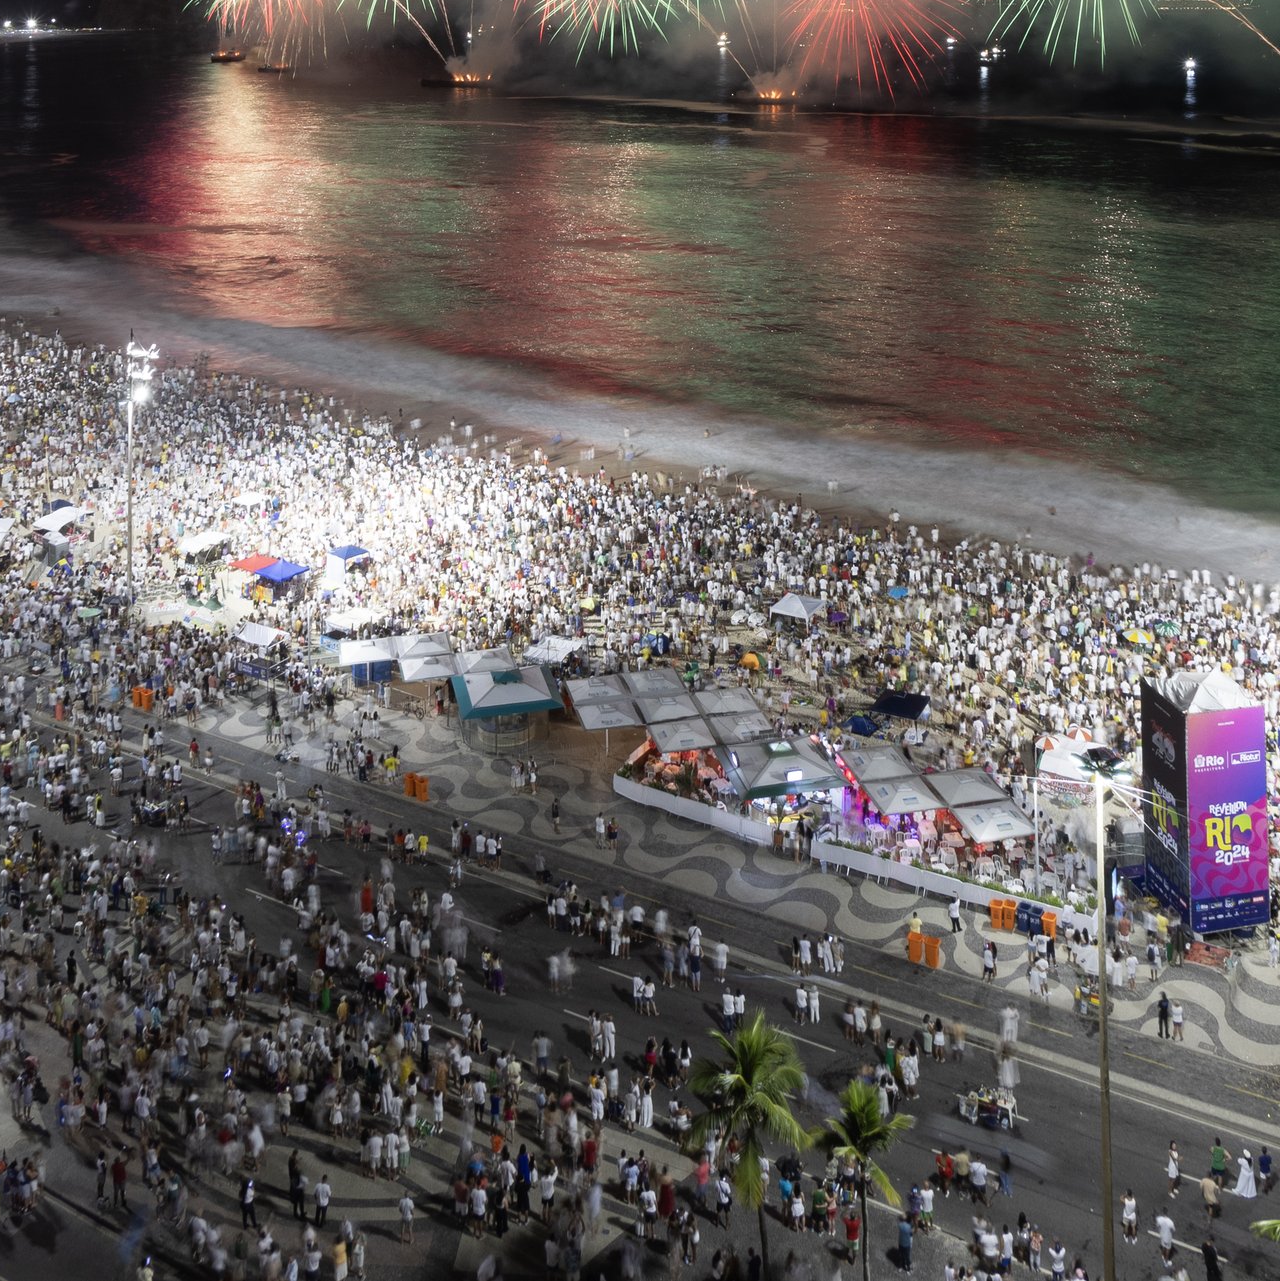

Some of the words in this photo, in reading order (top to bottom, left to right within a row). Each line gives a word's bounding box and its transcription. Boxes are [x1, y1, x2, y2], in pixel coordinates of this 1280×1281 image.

[1205, 754, 1225, 767] Rio
[1205, 814, 1253, 851] RIO
[1215, 844, 1250, 866] 2024
